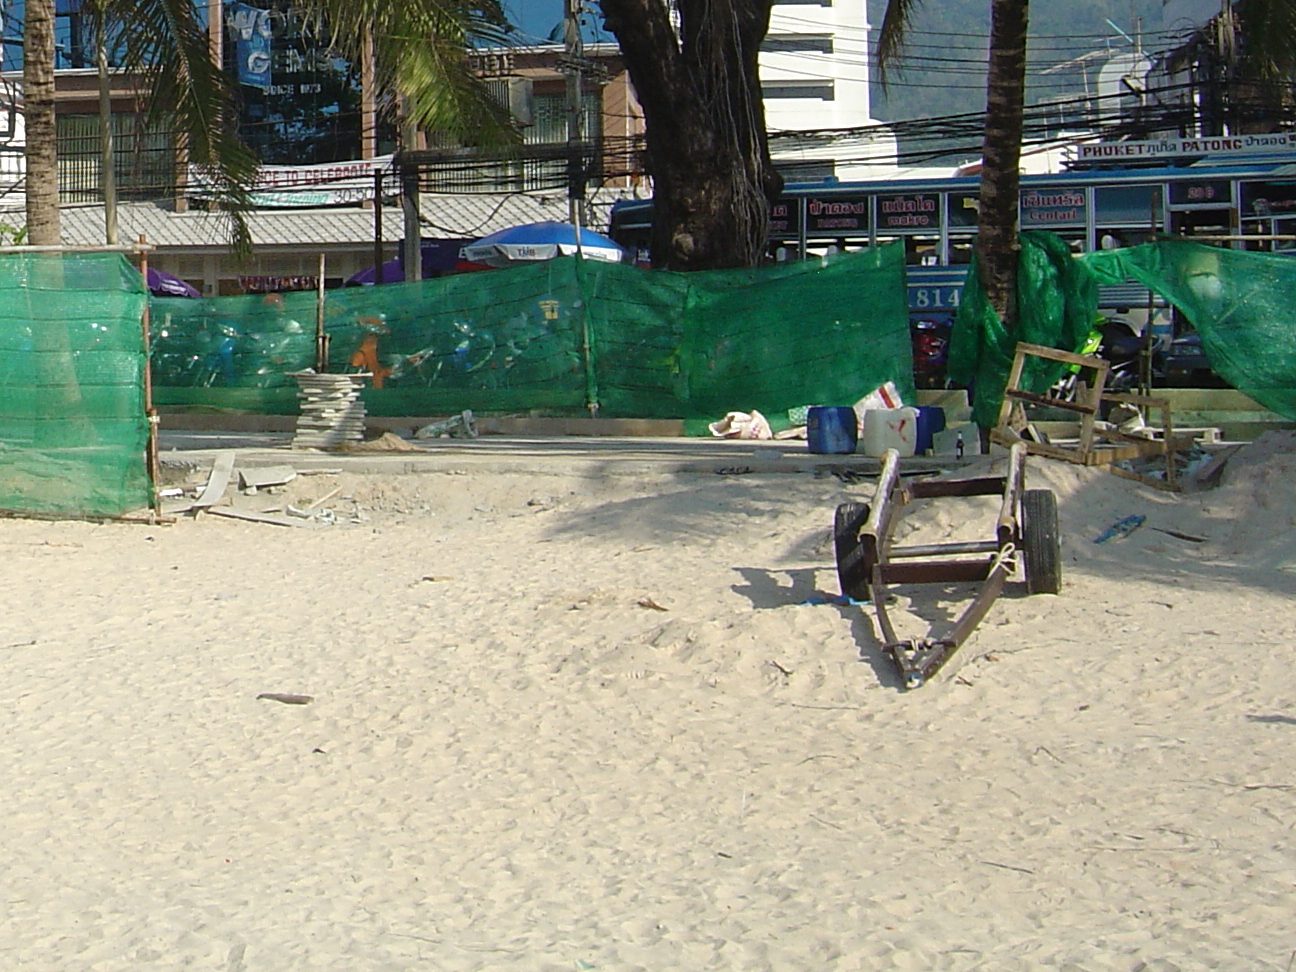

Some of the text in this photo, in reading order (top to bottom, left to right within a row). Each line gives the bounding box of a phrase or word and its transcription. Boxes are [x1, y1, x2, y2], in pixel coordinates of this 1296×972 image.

[1083, 143, 1145, 157] PHUKET
[1182, 138, 1243, 153] PATONG
[286, 169, 298, 186] TO
[888, 214, 929, 227] makro
